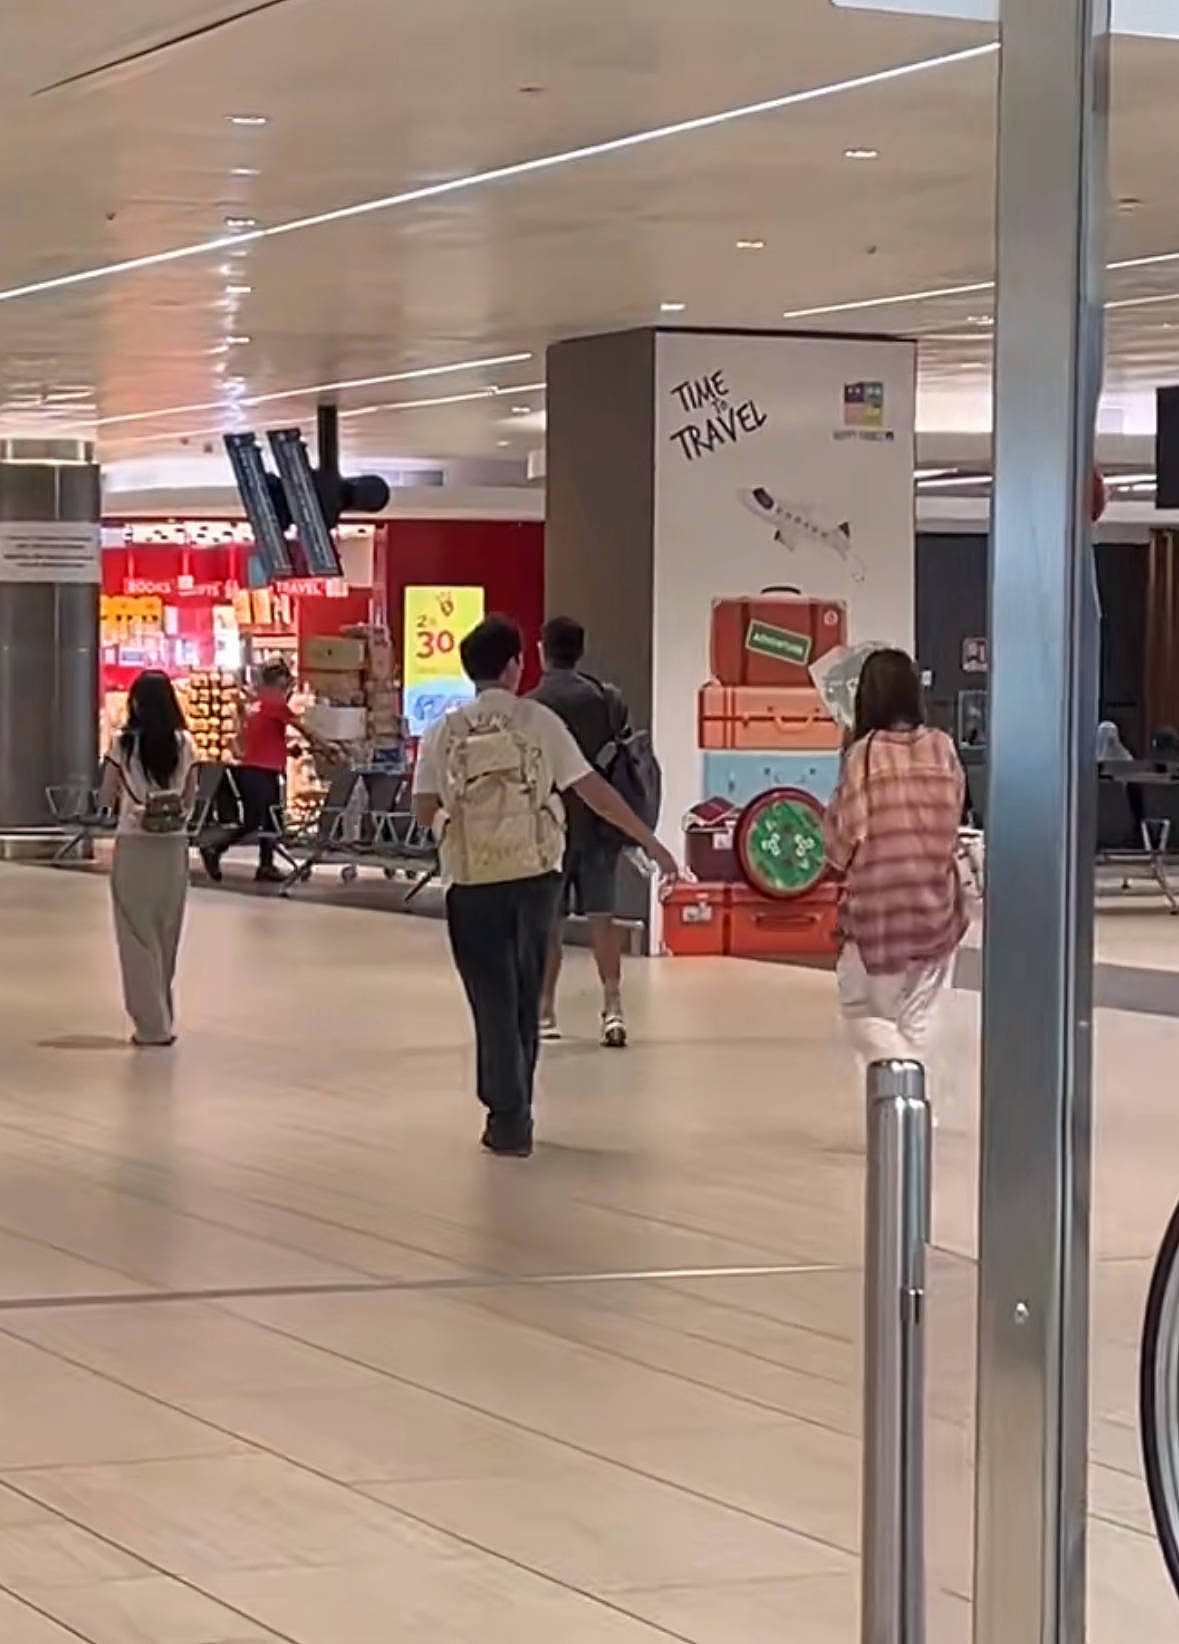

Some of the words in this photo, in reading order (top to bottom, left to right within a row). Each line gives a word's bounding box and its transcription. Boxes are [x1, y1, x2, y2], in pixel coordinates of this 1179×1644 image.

[670, 370, 729, 412] TIME
[669, 400, 767, 461] TRAVEL
[276, 581, 323, 595] TRAVEL
[416, 629, 455, 659] 30
